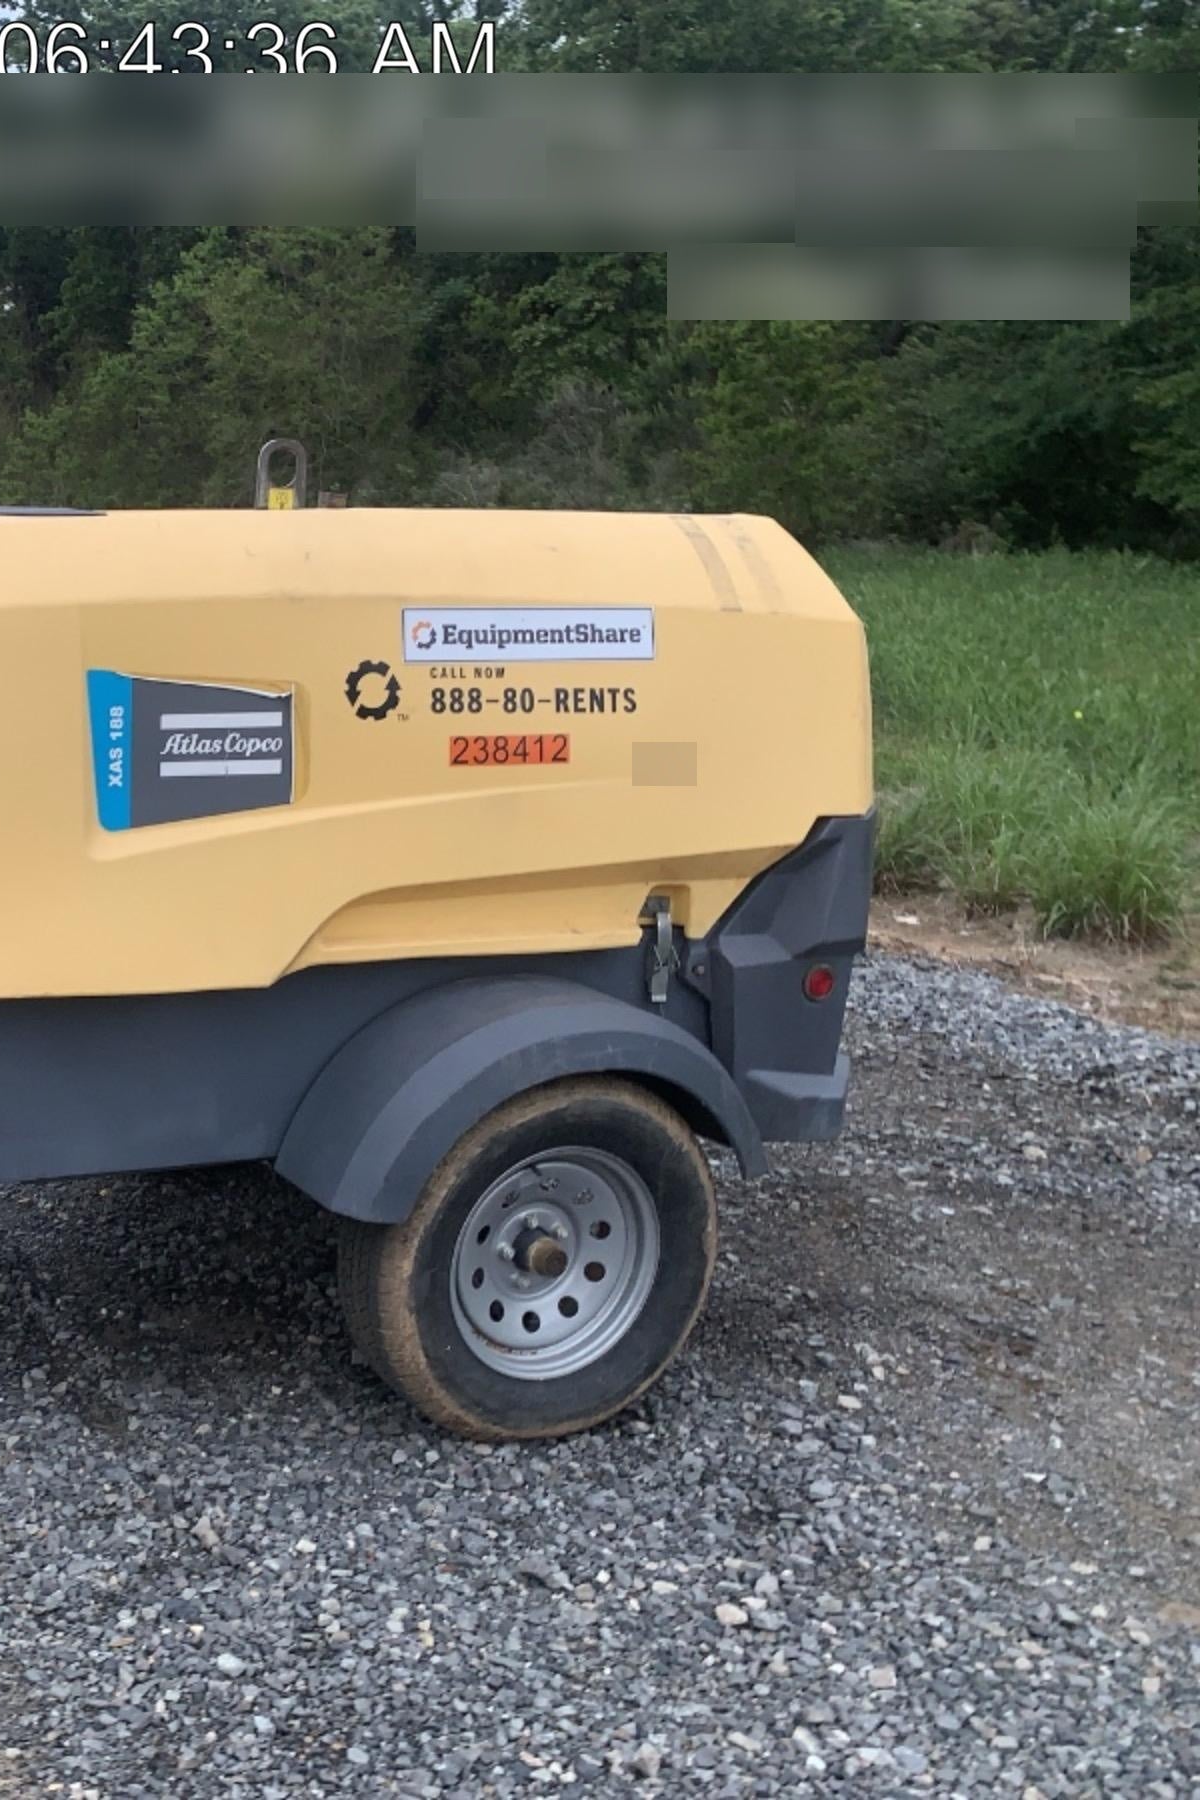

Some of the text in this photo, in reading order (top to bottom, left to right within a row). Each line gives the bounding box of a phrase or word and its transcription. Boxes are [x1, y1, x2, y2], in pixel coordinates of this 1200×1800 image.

[441, 621, 642, 649] EquipmentShare
[430, 667, 506, 680] CALL NOW
[430, 687, 638, 714] 888-80-RENTS
[108, 705, 125, 788] XAS 188
[451, 734, 569, 765] 238412
